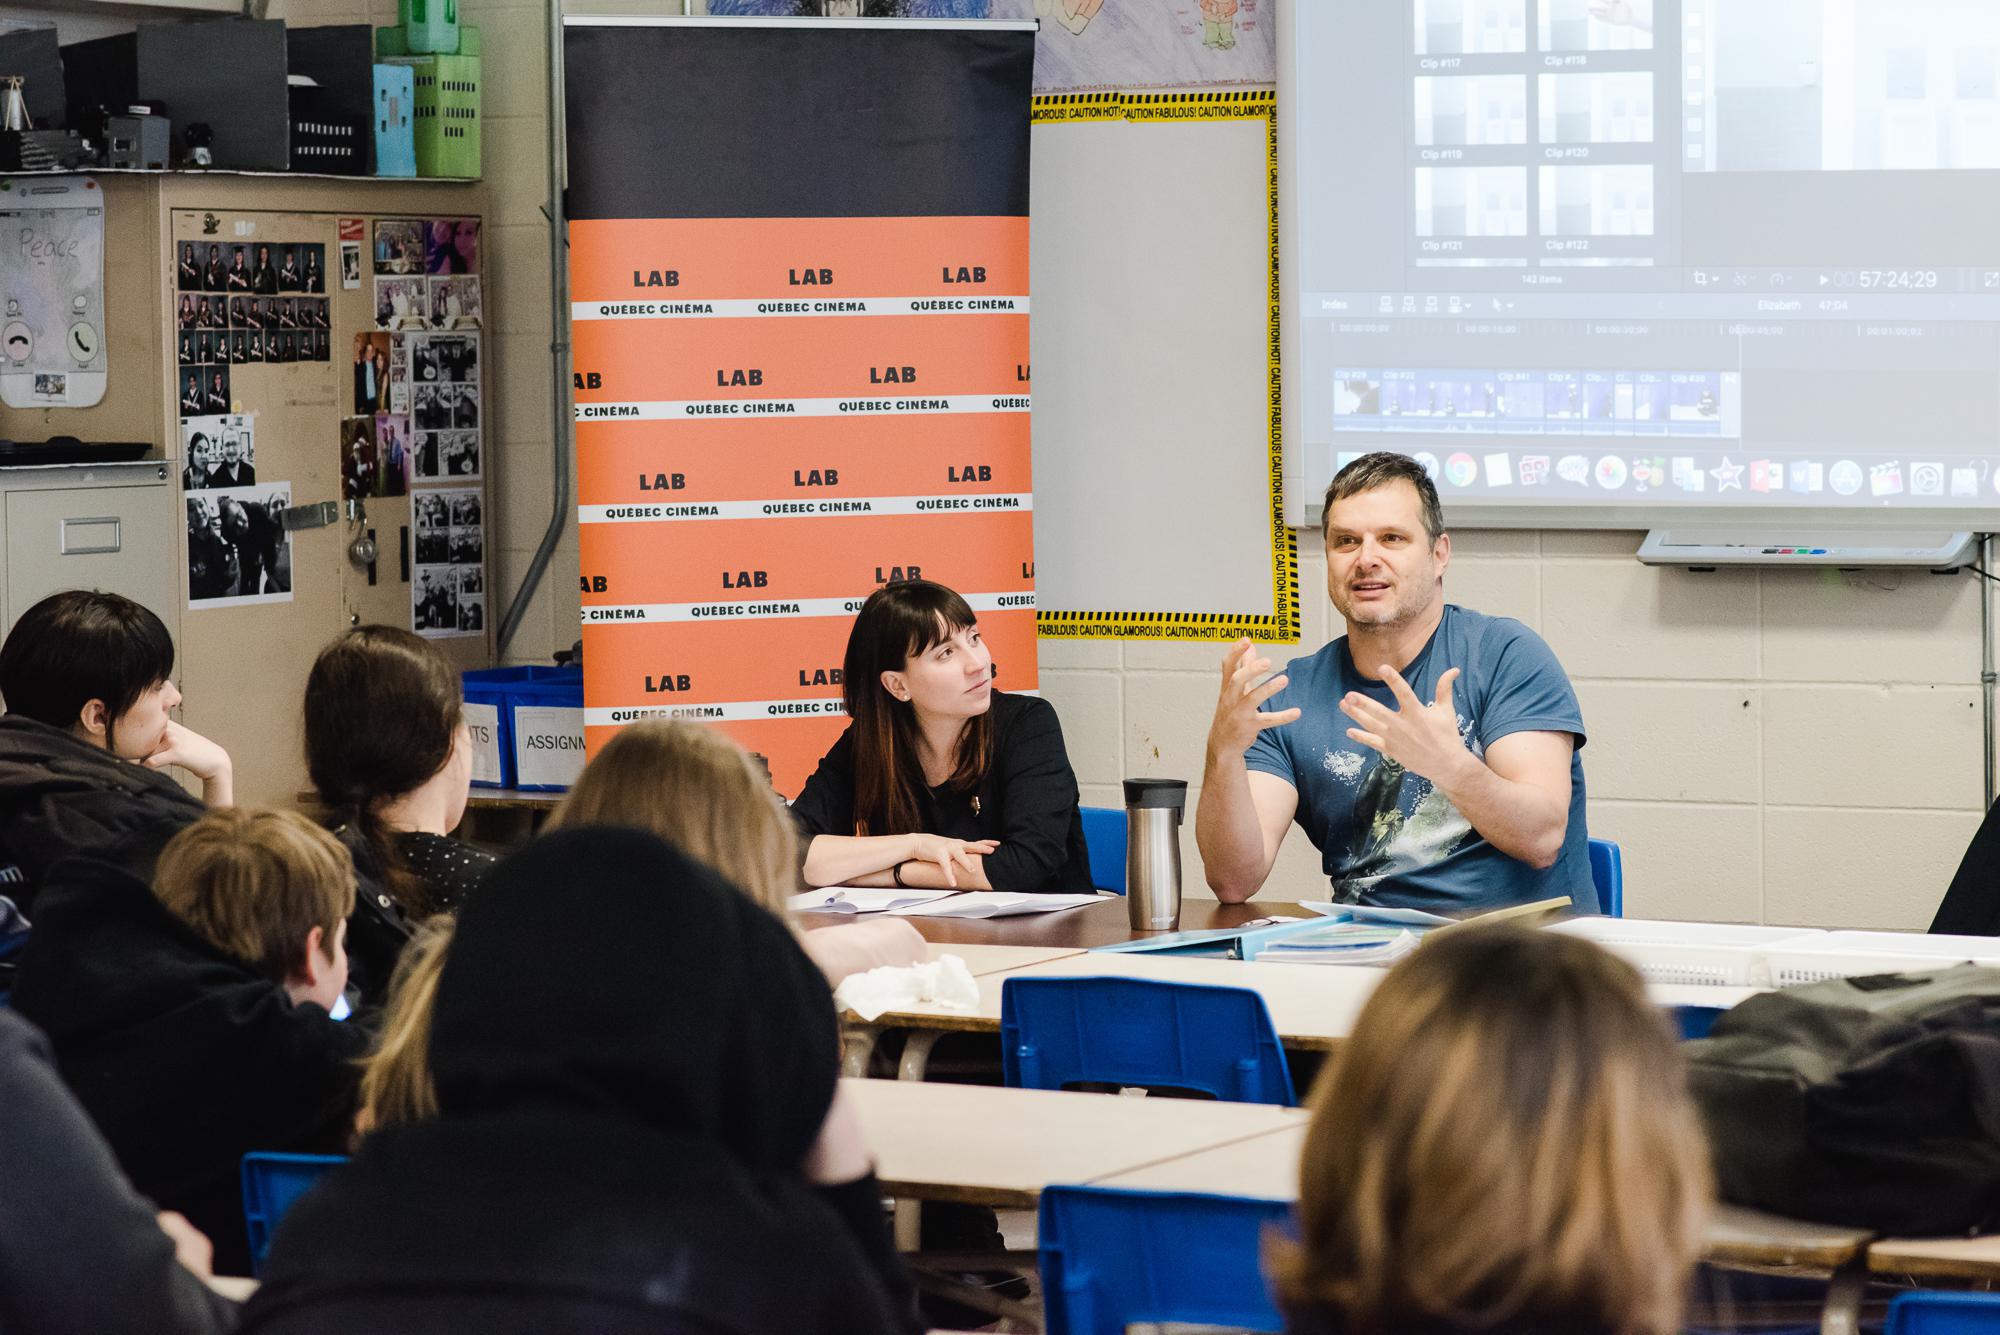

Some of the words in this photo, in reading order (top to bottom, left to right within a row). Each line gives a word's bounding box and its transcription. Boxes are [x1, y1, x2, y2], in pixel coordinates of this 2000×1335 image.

[1420, 57, 1439, 69] Clip
[1440, 57, 1460, 68] #117
[1544, 55, 1563, 67] Clip
[1069, 107, 1103, 119] CAUTION
[1103, 106, 1121, 117] HOT!
[1121, 108, 1154, 120] CAUTION
[1154, 107, 1197, 119] FABULOUS!
[1198, 106, 1232, 118] CAUTION
[1421, 149, 1439, 161] Clip
[1441, 149, 1462, 159] #119
[1545, 147, 1563, 159] Clip
[1565, 147, 1589, 157] #120
[19, 227, 79, 258] Peace
[1422, 240, 1439, 252] Clip
[1441, 240, 1463, 250] #121
[1546, 239, 1564, 251] Clip
[1565, 239, 1589, 250] #122
[633, 270, 680, 287] LAB
[788, 268, 833, 286] LAB
[942, 267, 987, 283] LAB
[1522, 274, 1537, 284] 142
[1539, 274, 1563, 284] items
[1859, 270, 1937, 289] 57:24;29
[600, 302, 655, 316] QUÉBEC
[660, 302, 713, 315] CINÉMA
[757, 301, 810, 314] QUÉBEC
[814, 300, 866, 313] CINÉMA
[910, 299, 964, 312] QUÉBEC
[968, 298, 1015, 312] CINÉMA
[1321, 299, 1348, 310] Index
[1758, 299, 1801, 311] Elizabeth
[1271, 305, 1280, 343] CAUTION
[1271, 345, 1281, 365] HOT!
[717, 369, 763, 387] LAB
[870, 366, 917, 384] LAB
[1335, 370, 1351, 380] Clip
[1383, 371, 1399, 381] Clip
[1498, 372, 1514, 383] Clip
[1671, 374, 1688, 385] Clip
[1271, 367, 1281, 405] CAUTION
[584, 404, 640, 418] CINÉMA
[685, 402, 739, 416] QUÉBEC
[743, 401, 796, 415] CINÉMA
[838, 399, 892, 413] QUÉBEC
[896, 397, 949, 412] CINÉMA
[992, 396, 1030, 410] QUÉBEC
[1271, 407, 1282, 454] FABULOUS!
[639, 473, 686, 491] LAB
[794, 469, 838, 486] LAB
[948, 465, 992, 483] LAB
[1272, 456, 1283, 493] CAUTION
[762, 502, 815, 516] QUÉBEC
[819, 500, 872, 513] CINÉMA
[916, 497, 969, 511] QUÉBEC
[973, 496, 1020, 509] CINÉMA
[605, 506, 662, 520] QUÉBEC
[665, 504, 719, 518] CINÉMA
[1273, 495, 1285, 552] GLAMOROUS!
[722, 570, 768, 589] LAB
[875, 566, 922, 583] LAB
[1275, 554, 1287, 591] CAUTION
[997, 593, 1035, 608] QUÉBEC
[590, 607, 645, 621] CINÉMA
[690, 604, 745, 619] QUÉBEC
[749, 603, 801, 616] CINÉMA
[1277, 593, 1289, 640] FABULOUS!
[1038, 624, 1079, 637] FABULOUS!
[1079, 625, 1113, 637] CAUTION
[1113, 625, 1163, 638] GLAMOROUS!
[1165, 626, 1198, 638] CAUTION
[1199, 626, 1218, 639] HOT!
[1220, 627, 1254, 640] CAUTION
[644, 674, 691, 693] LAB
[799, 668, 843, 686] LAB
[671, 707, 724, 719] CINÉMA
[767, 703, 821, 717] QUÉBEC
